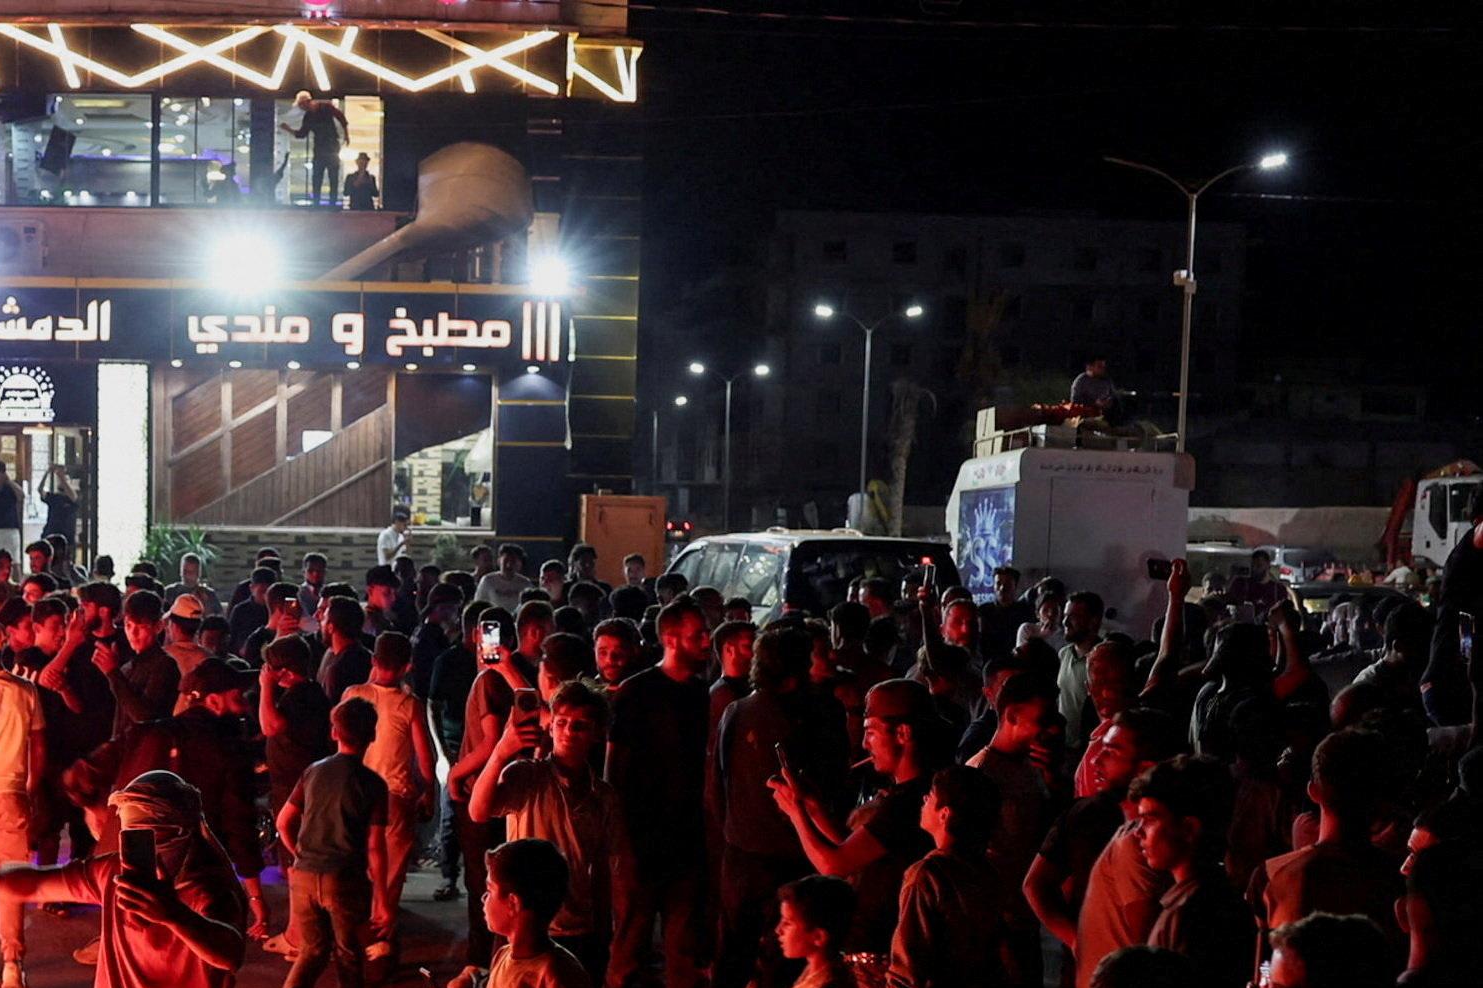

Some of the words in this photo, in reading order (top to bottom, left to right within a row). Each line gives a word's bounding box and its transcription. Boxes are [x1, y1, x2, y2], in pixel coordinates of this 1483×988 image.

[187, 305, 311, 354] مندي
[331, 311, 365, 357] و
[386, 306, 512, 357] مطبخ
